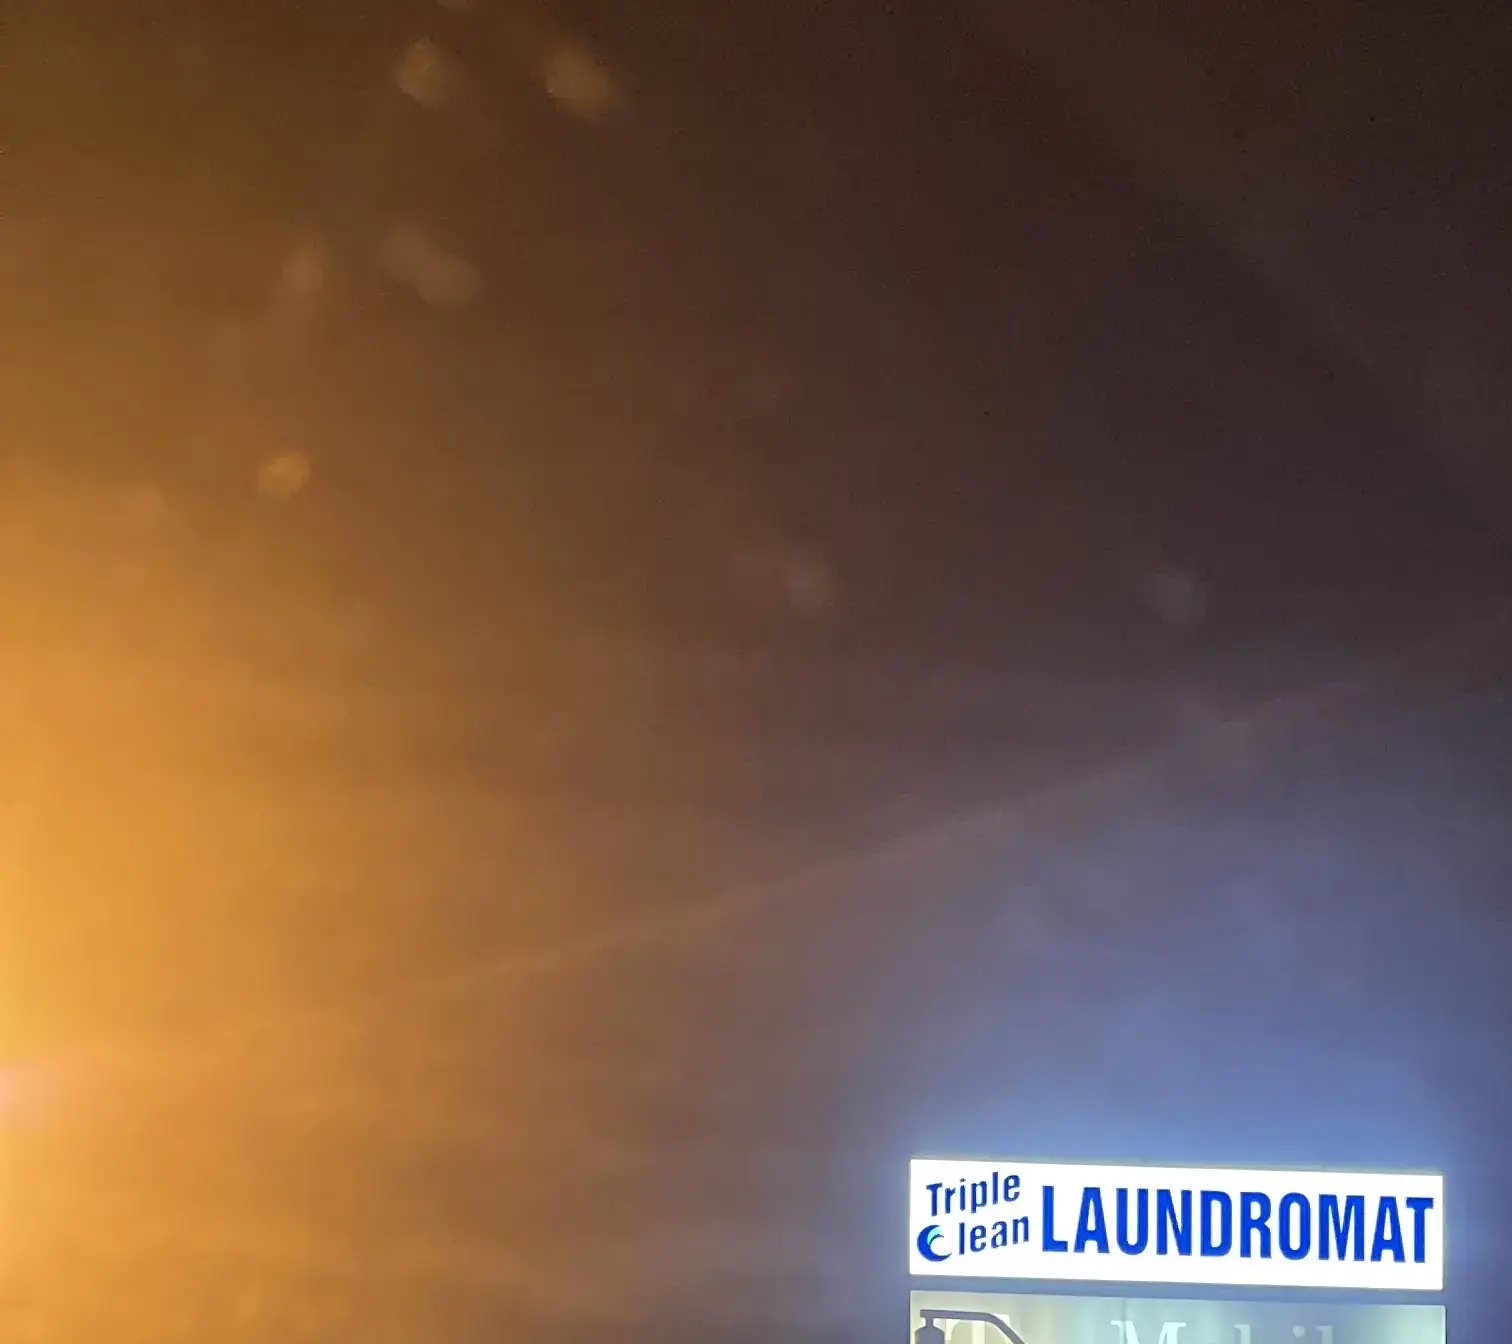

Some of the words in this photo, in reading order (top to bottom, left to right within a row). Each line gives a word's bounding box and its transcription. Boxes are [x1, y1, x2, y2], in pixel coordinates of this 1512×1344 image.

[926, 1171, 1021, 1216] Triple
[917, 1216, 1029, 1262] Clean
[1041, 1184, 1435, 1264] LAUNDROMAT
